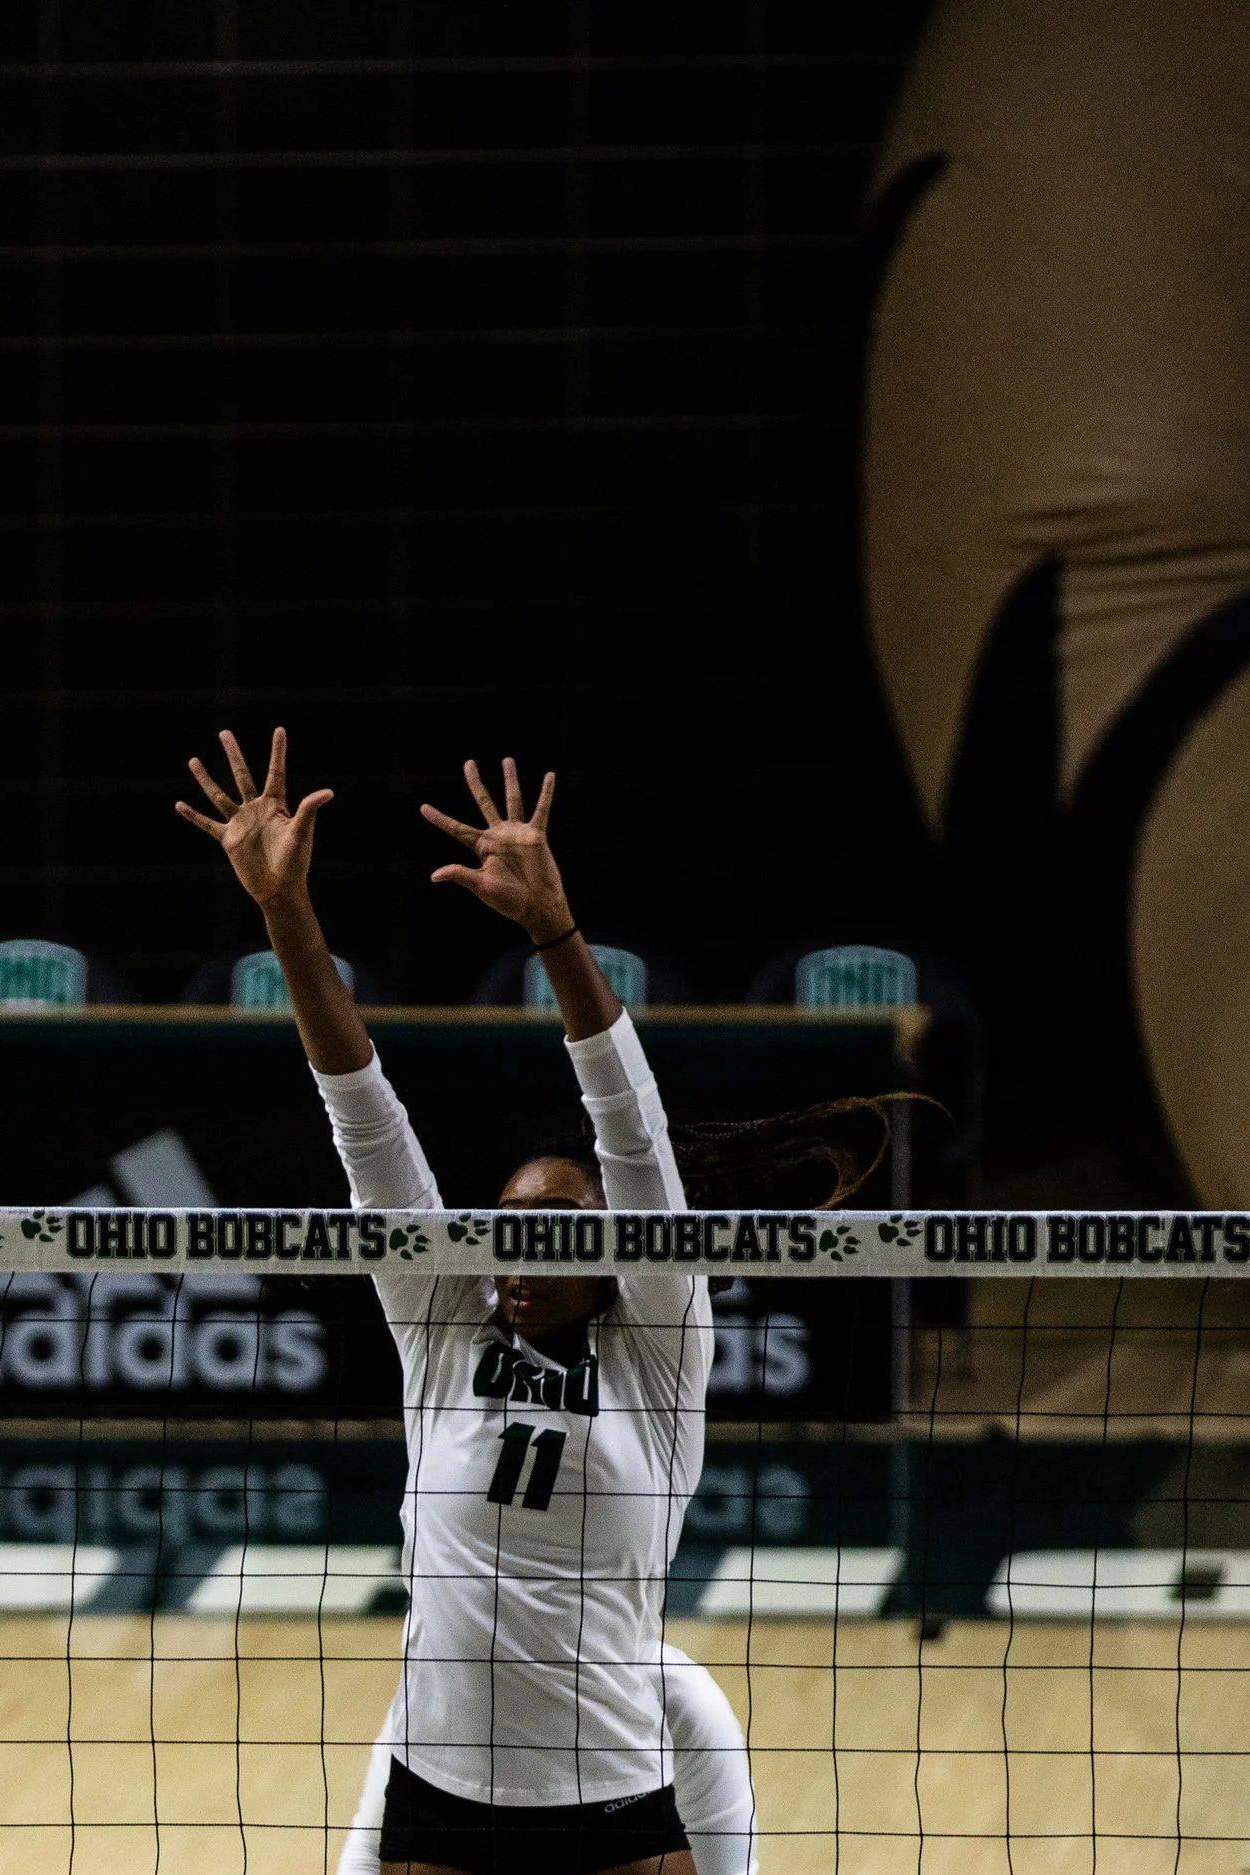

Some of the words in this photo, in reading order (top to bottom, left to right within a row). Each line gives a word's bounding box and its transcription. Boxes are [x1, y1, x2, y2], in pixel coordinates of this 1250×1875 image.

[66, 1212, 178, 1259] OHIO
[186, 1213, 387, 1261] BOBCATS
[493, 1214, 605, 1262] OHIO
[614, 1215, 817, 1263] BOBCATS
[924, 1215, 1037, 1263] OHIO
[1047, 1216, 1250, 1264] BOBCATS
[486, 1421, 567, 1512] 11
